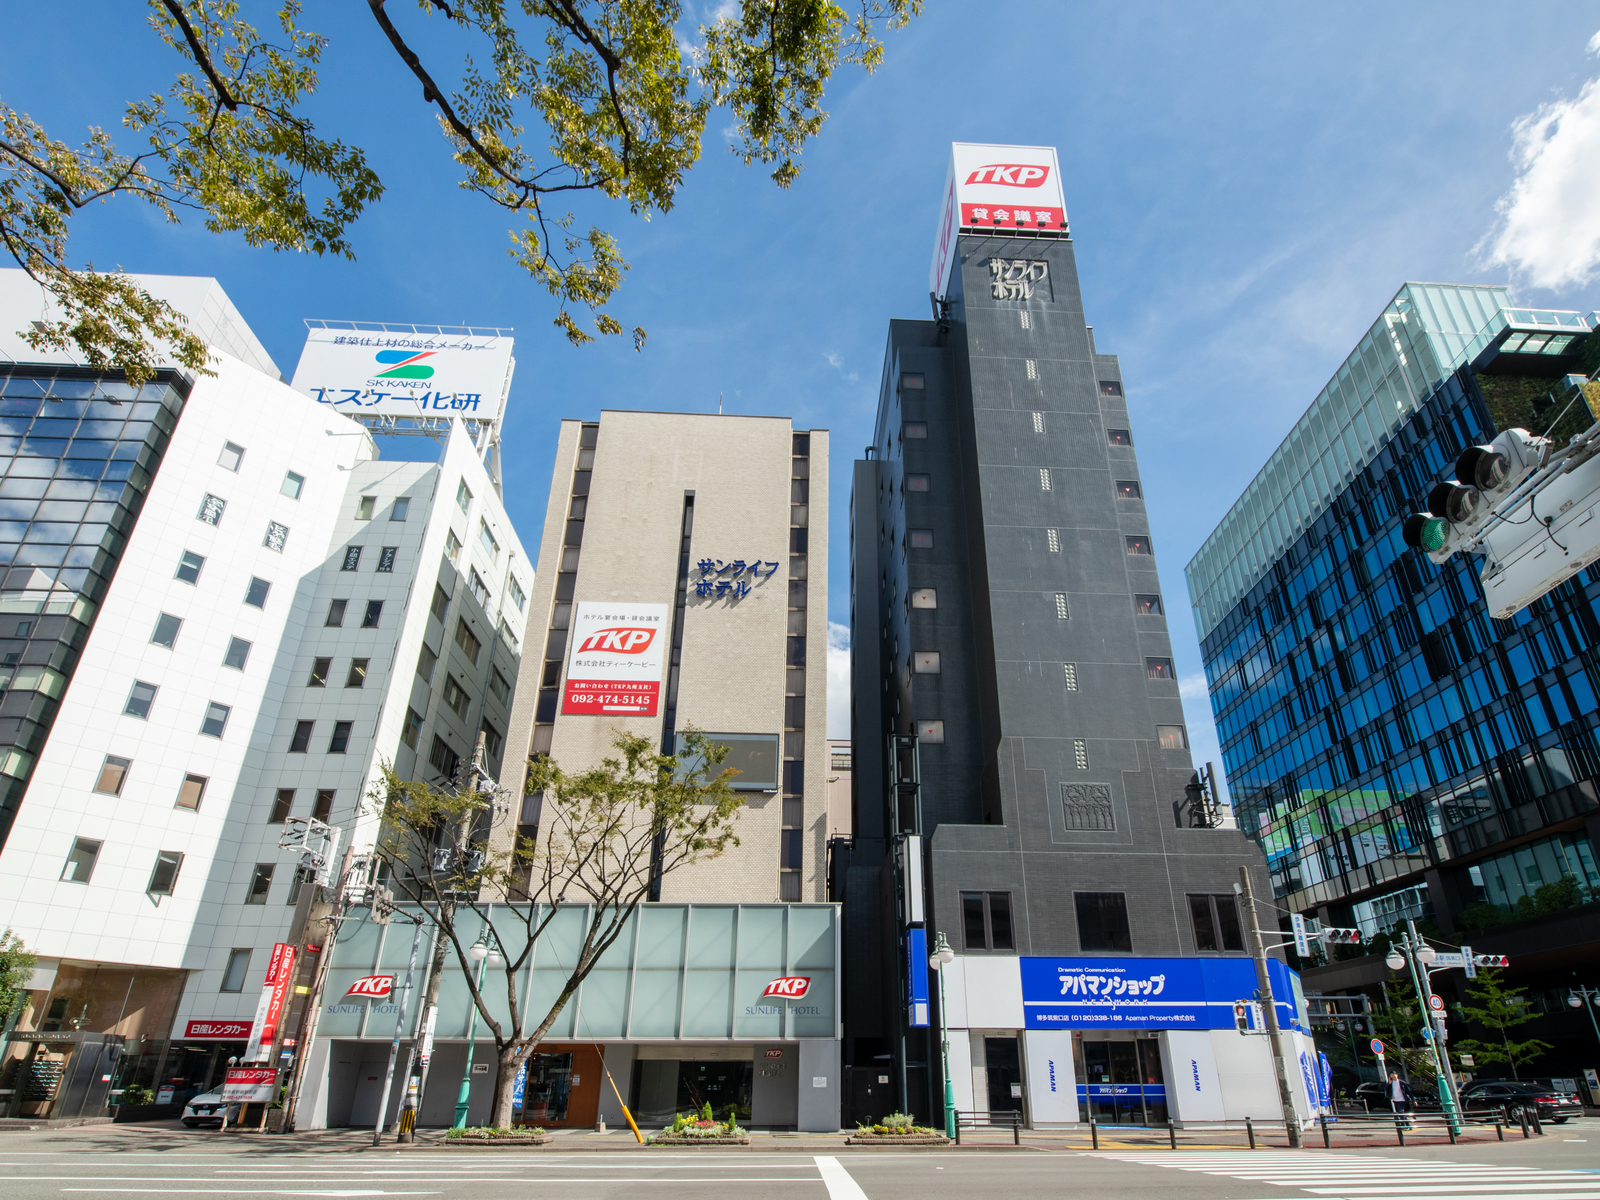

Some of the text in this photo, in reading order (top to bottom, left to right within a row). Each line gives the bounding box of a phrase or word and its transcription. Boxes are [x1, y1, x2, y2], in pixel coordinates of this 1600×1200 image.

[972, 165, 1045, 186] TKP
[971, 207, 1053, 223] 貸会議室
[989, 258, 1048, 281] サンライフ
[992, 279, 1035, 300] ホテル
[333, 336, 487, 351] 建築仕上材の総合メーカー
[365, 379, 432, 389] SK KAKEN
[310, 388, 482, 412] エスケー化研
[696, 558, 780, 577] サンライフ
[696, 580, 752, 599] ホテル
[583, 614, 660, 622] ホテル宴会場・貸会議室
[585, 630, 651, 651] TKP
[571, 694, 650, 705] 092-474-5145
[270, 946, 294, 1020] 日産レンタカー
[352, 978, 391, 992] TKP
[768, 979, 808, 993] TKP
[1059, 974, 1165, 995] アパマンショップ
[327, 1005, 365, 1014] SUNLIFE
[1433, 999, 1440, 1007] 40
[190, 1024, 248, 1033] 日産レンタカー
[228, 1070, 275, 1079] 日産レンタカー
[1048, 1059, 1057, 1093] APAMAN
[1191, 1059, 1201, 1092] APAMAN
